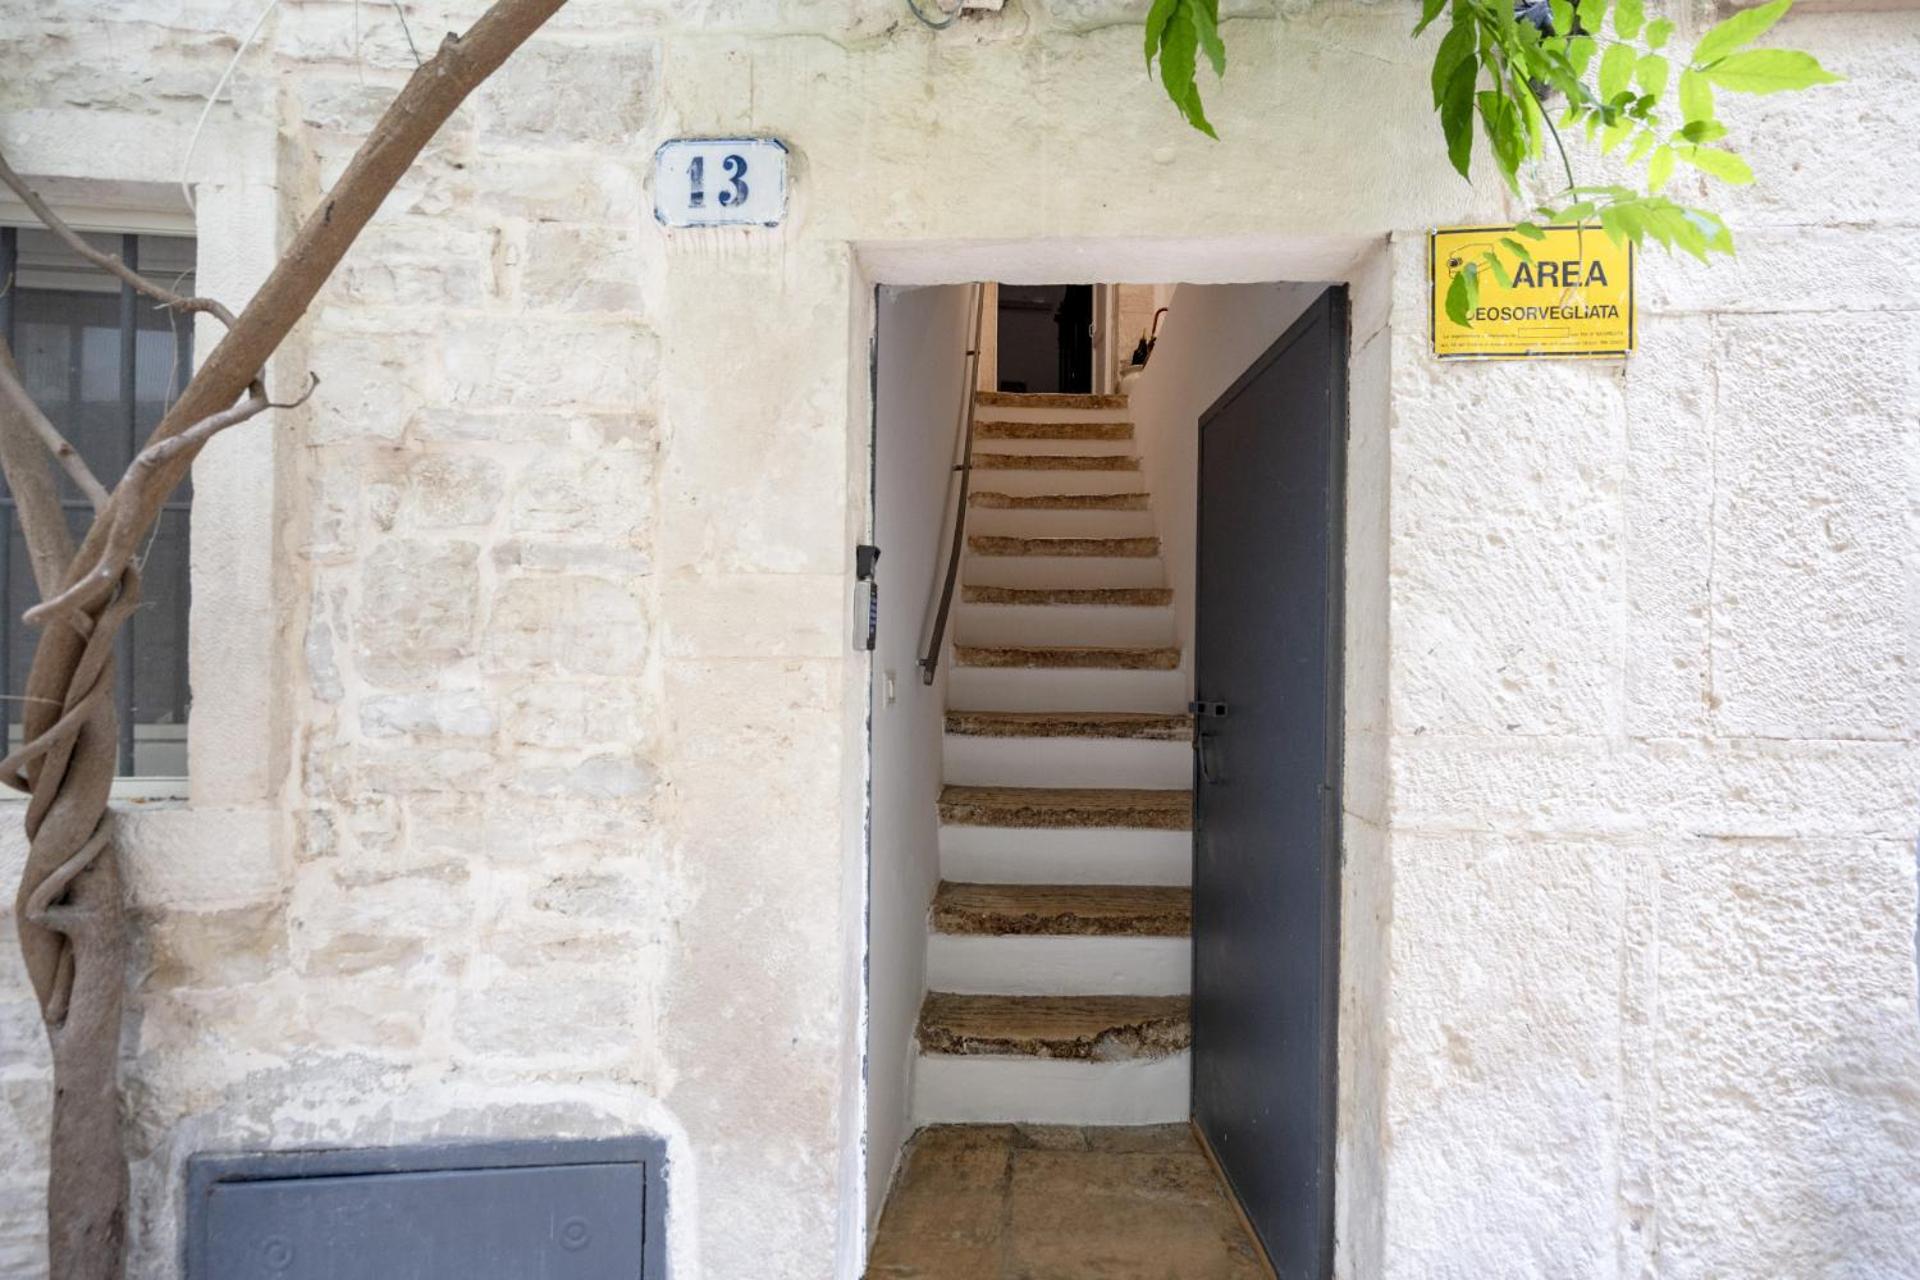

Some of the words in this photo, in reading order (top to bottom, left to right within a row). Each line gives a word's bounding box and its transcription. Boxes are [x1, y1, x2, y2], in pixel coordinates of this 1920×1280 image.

[687, 154, 749, 208] 13
[1512, 260, 1608, 288] AREA
[1465, 305, 1619, 321] EOSORVEGLIATA
